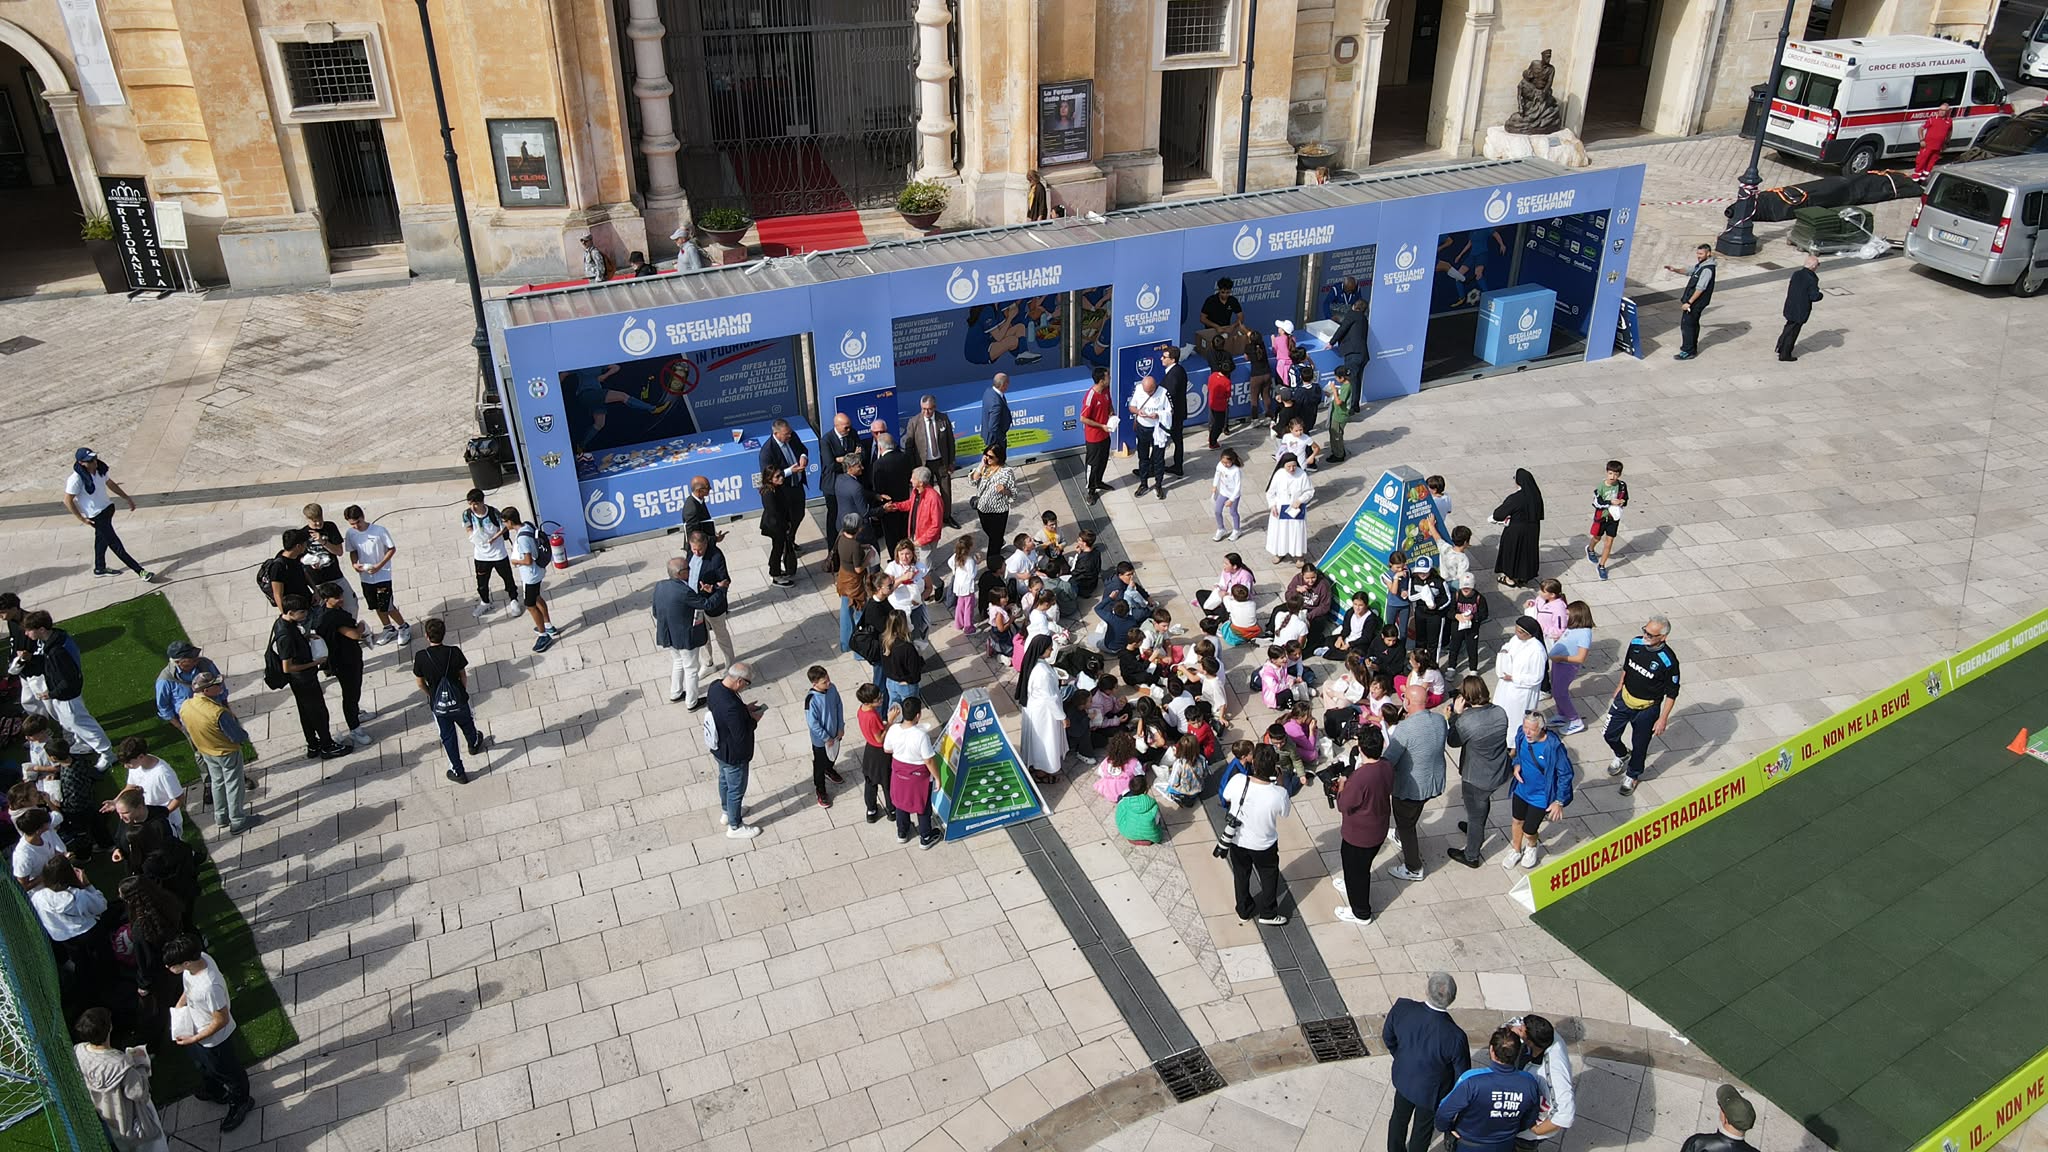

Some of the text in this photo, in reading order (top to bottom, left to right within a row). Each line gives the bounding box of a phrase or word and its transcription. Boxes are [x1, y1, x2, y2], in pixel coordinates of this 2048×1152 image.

[1899, 61, 1927, 69] ROSSA
[1928, 58, 1966, 67] ITALIANA
[1516, 189, 1576, 208] SCEGLIAMO
[1518, 199, 1572, 215] DA CAMPIONI
[1268, 224, 1335, 244] SCEGLIAMO
[116, 207, 147, 286] RISTORANTE
[137, 208, 167, 287] PIZZERIA
[1270, 234, 1332, 252] DA CAMPIONI
[987, 264, 1062, 287] SCEGLIAMO
[1383, 267, 1425, 281] SCEGLIAMO
[990, 275, 1060, 295] DA CAMPIONI
[1124, 308, 1171, 323] SCEGLIAMO
[1137, 315, 1169, 326] CAMPIONI
[665, 312, 752, 337] SCEGLIAMO
[670, 323, 750, 345] DA CAMPIONI
[695, 349, 708, 364] IN
[742, 357, 786, 371] DIFESA ALTA
[828, 355, 881, 371] SCEGLIAMO
[720, 365, 787, 383] CONTRO L'UTILIZZO
[844, 362, 880, 374] CAMPIONI
[740, 379, 788, 393] PREVENZIONE
[747, 371, 787, 385] DELL'ALCOL
[695, 386, 789, 408] DEGLI INCIDENTI STRADALI
[1011, 414, 1045, 427] ASSIONE
[639, 503, 662, 518] DA
[1955, 639, 2011, 679] FEDERAZIONE
[1801, 688, 1910, 761] IO... NON ME LA BEVO!
[1550, 776, 1746, 891] #EDUCAZIONESTRADALEFMI
[1503, 1091, 1523, 1102] TIM
[1503, 1101, 1520, 1110] FIAT
[1969, 1076, 2045, 1150] IO... NON ME
